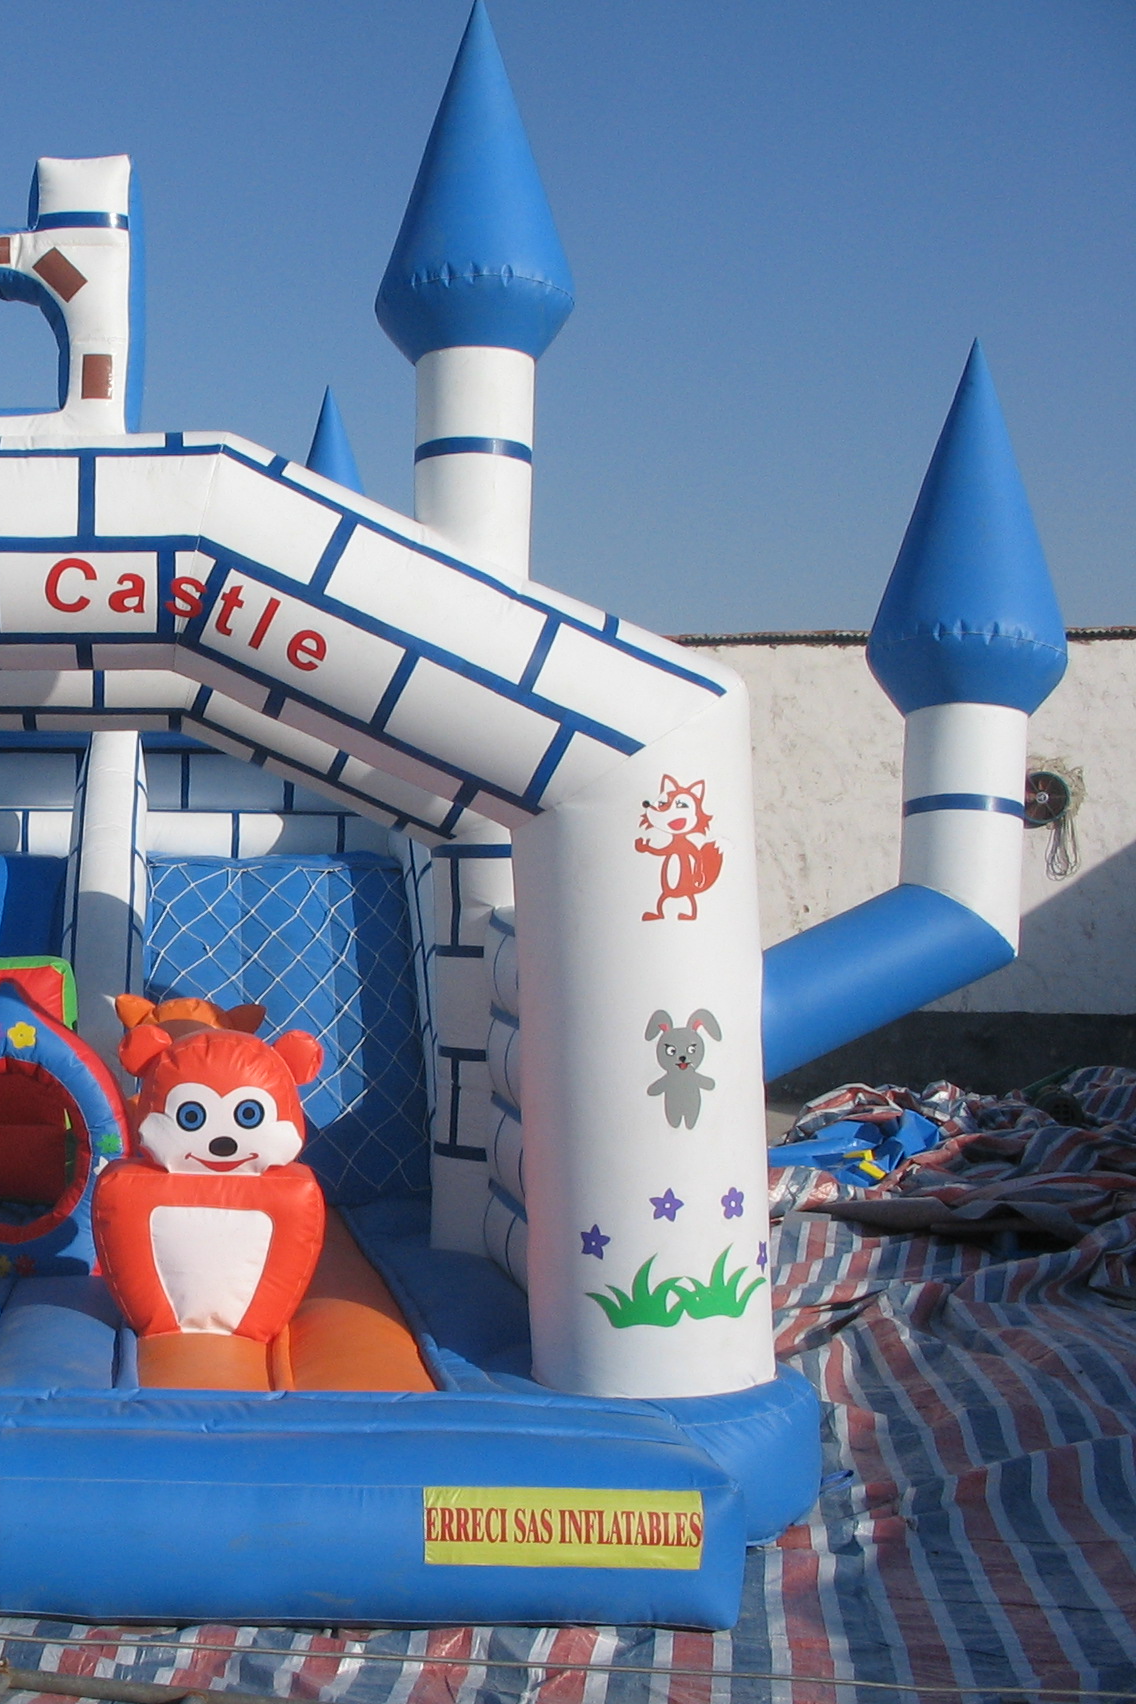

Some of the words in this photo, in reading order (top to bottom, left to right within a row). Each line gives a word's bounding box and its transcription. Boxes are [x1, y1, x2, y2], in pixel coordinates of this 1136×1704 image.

[45, 558, 328, 672] Castle
[425, 1507, 507, 1542] ERRECI
[514, 1508, 553, 1544] SAS
[559, 1509, 703, 1547] INFLATABLES
